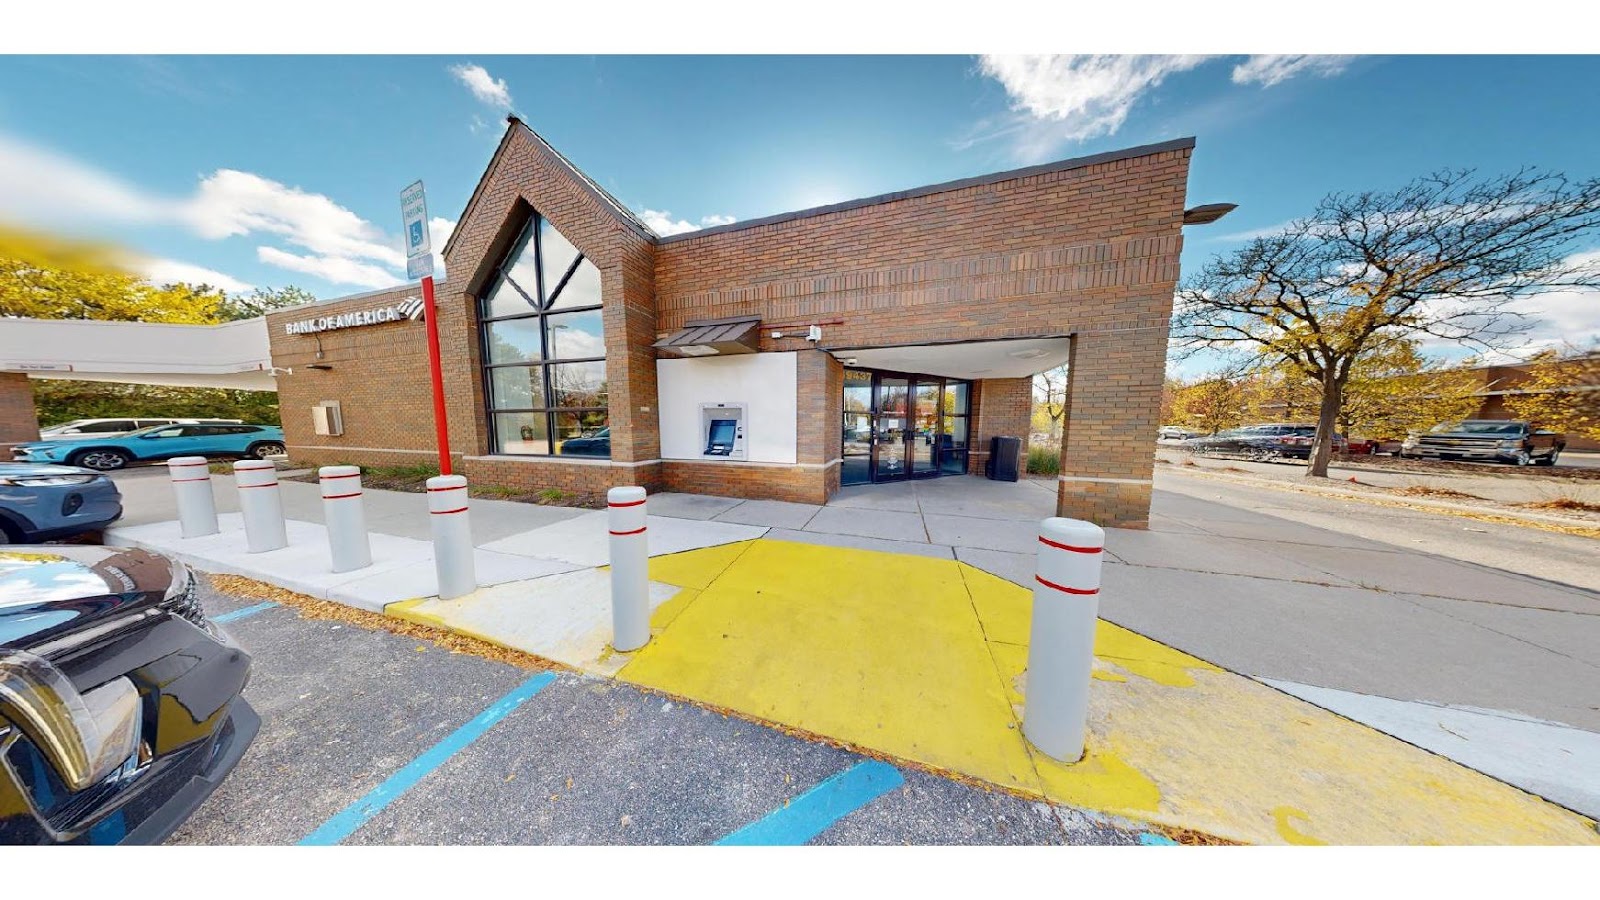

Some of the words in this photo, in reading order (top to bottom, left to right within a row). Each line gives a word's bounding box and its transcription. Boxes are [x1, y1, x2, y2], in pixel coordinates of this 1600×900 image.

[285, 319, 317, 335] BANK
[318, 316, 336, 330] OF
[336, 307, 397, 328] AMERICA
